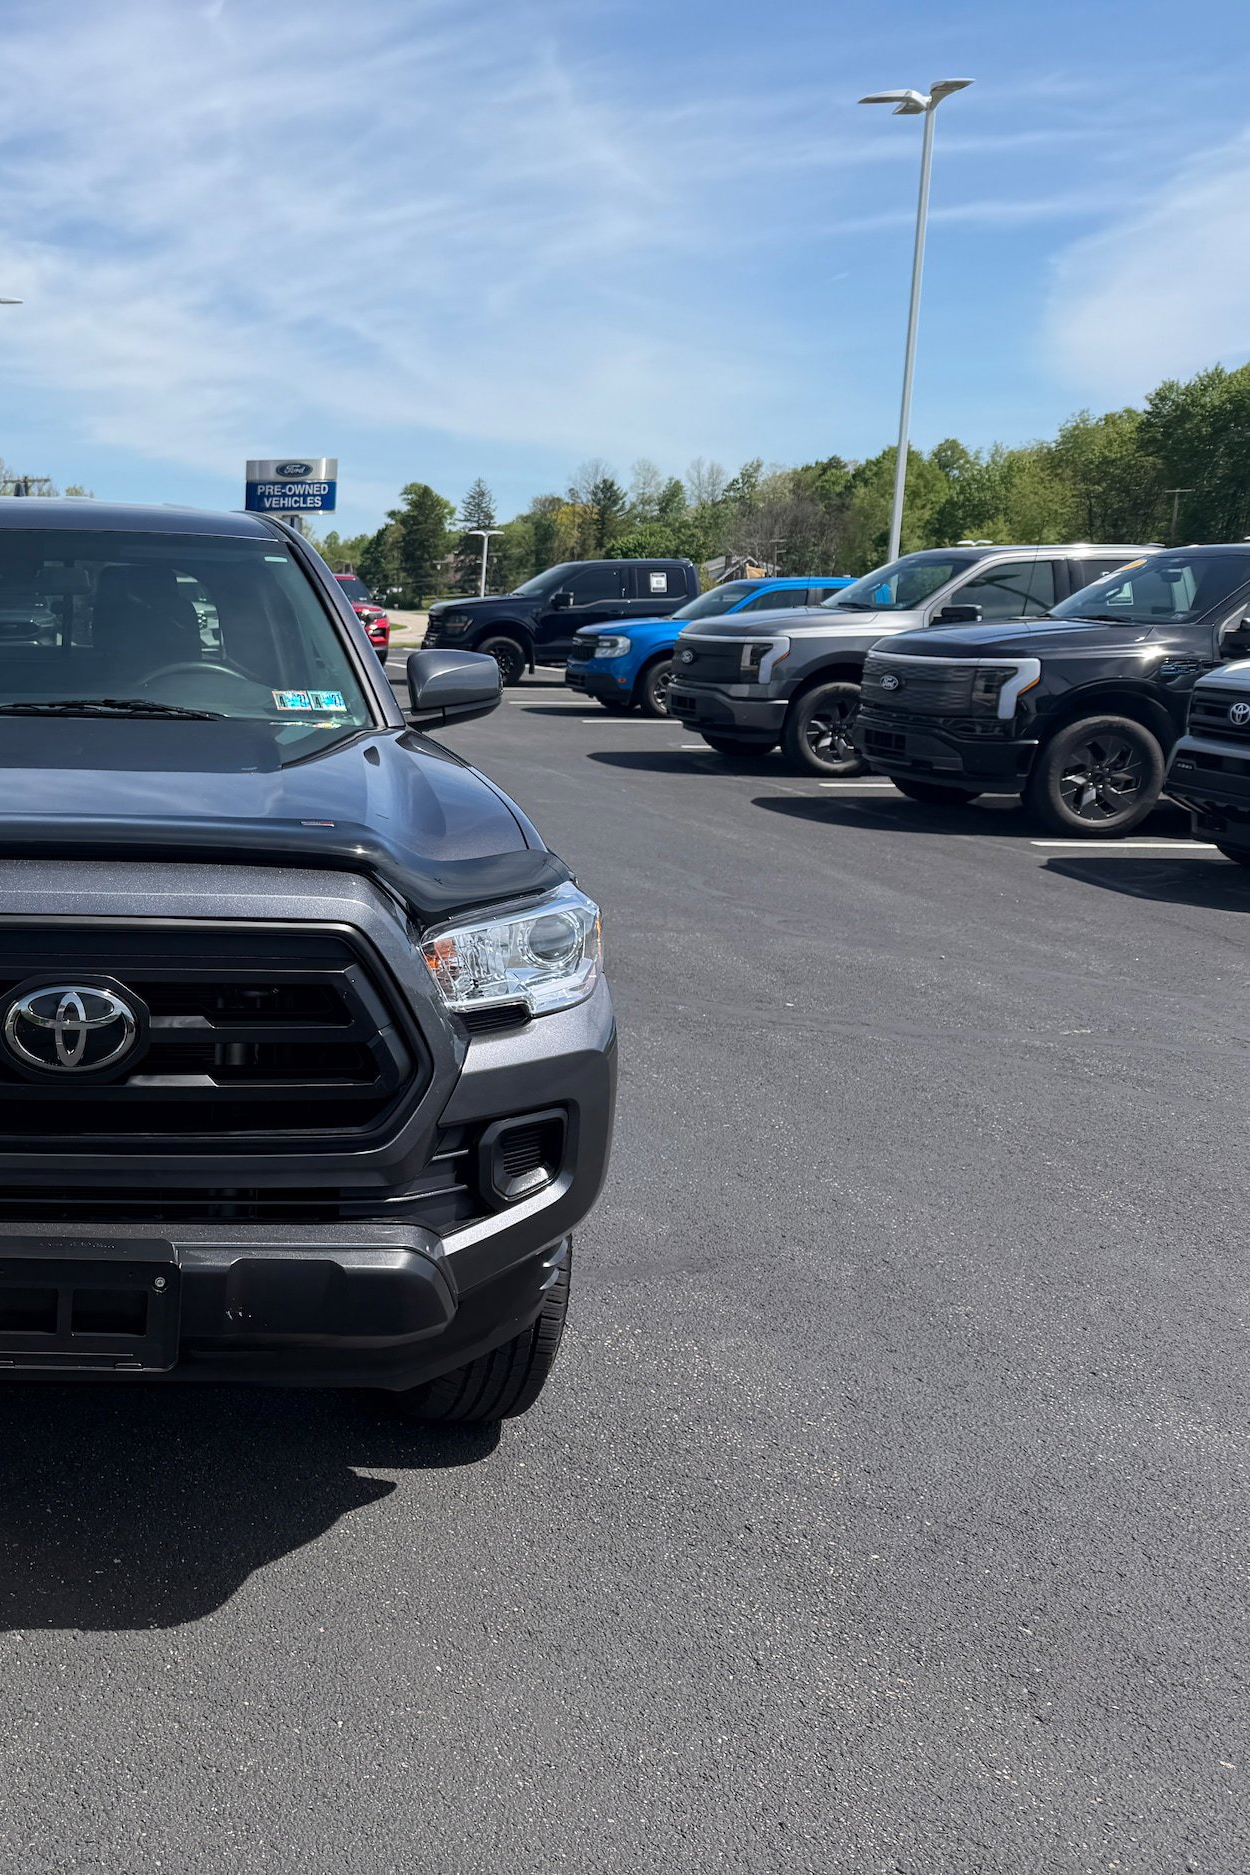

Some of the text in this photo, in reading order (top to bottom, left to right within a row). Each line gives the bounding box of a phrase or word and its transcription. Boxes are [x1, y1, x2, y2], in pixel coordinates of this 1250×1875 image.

[284, 464, 306, 474] Ford
[257, 484, 329, 496] PRE-OWNED
[264, 496, 322, 508] VEHICLES
